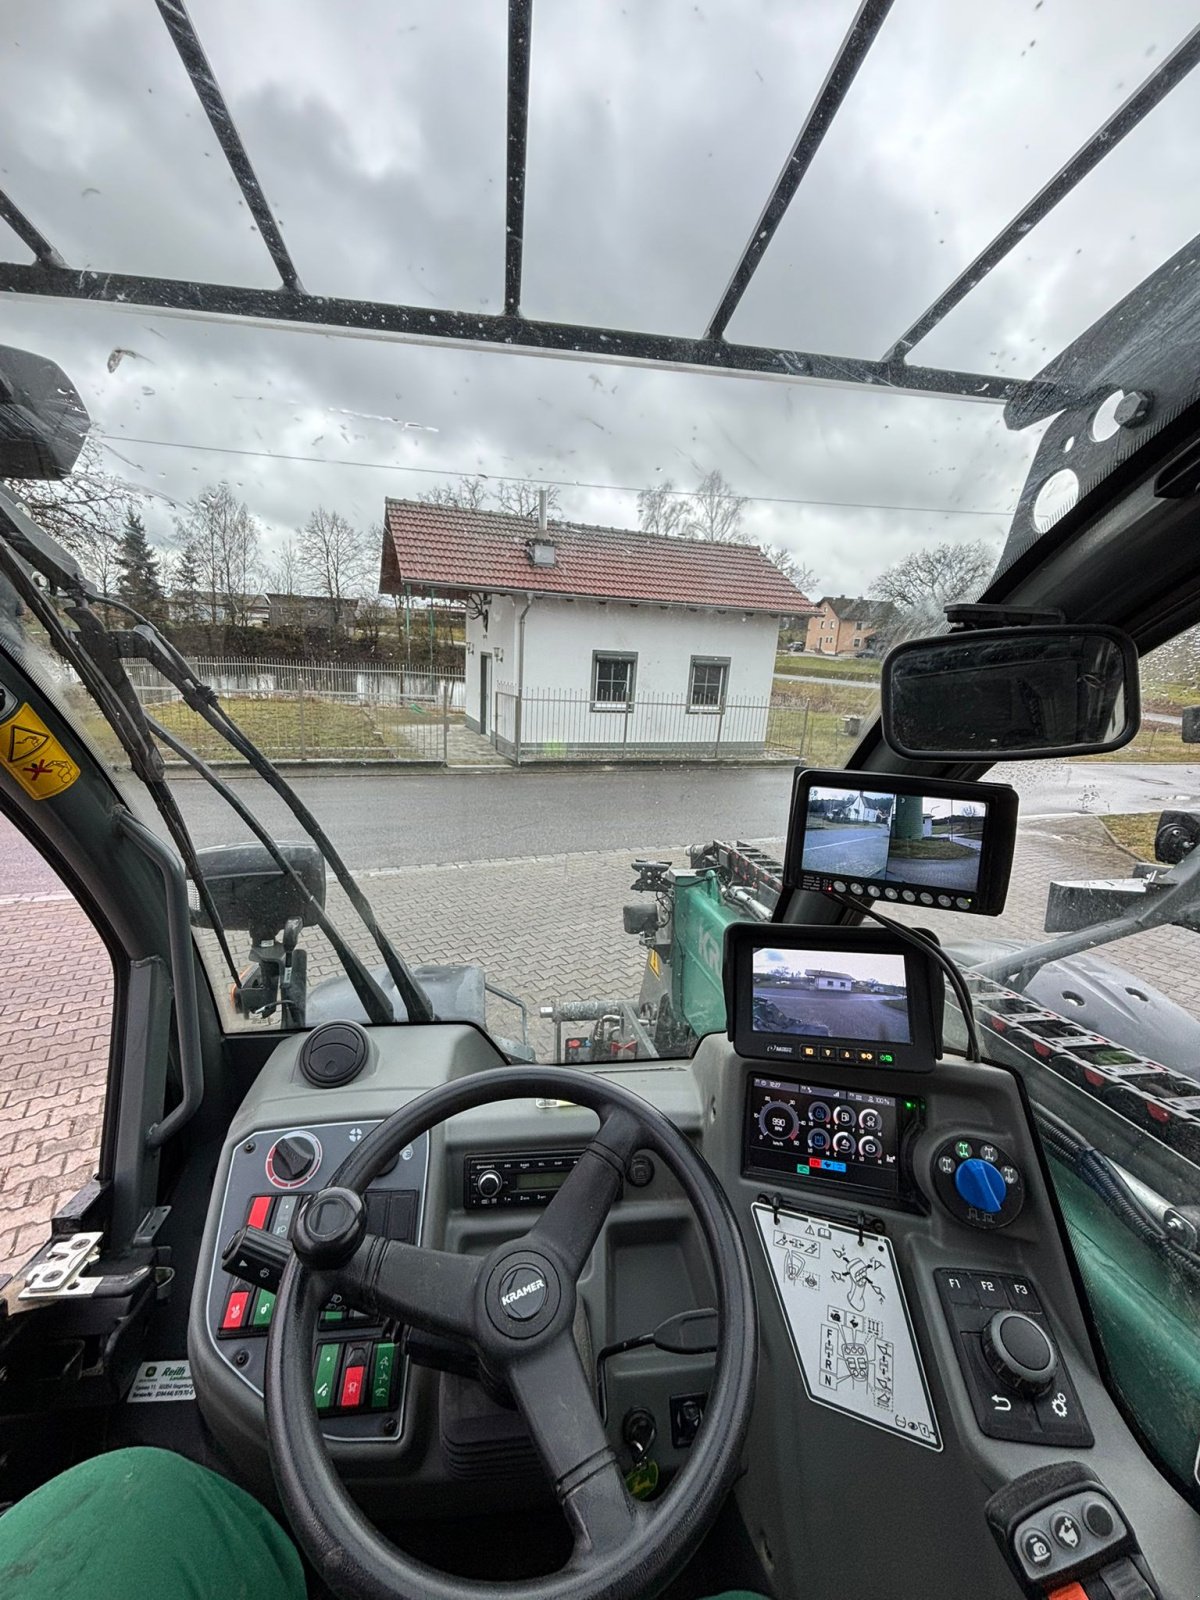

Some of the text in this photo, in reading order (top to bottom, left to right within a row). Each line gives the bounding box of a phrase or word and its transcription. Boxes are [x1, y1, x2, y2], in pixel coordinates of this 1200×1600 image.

[948, 1278, 961, 1289] F1
[980, 1280, 995, 1292] F2
[1013, 1284, 1028, 1295] F3
[501, 1279, 545, 1306] KRAMER
[826, 1328, 833, 1339] F
[825, 1359, 832, 1371] R
[824, 1374, 832, 1387] N
